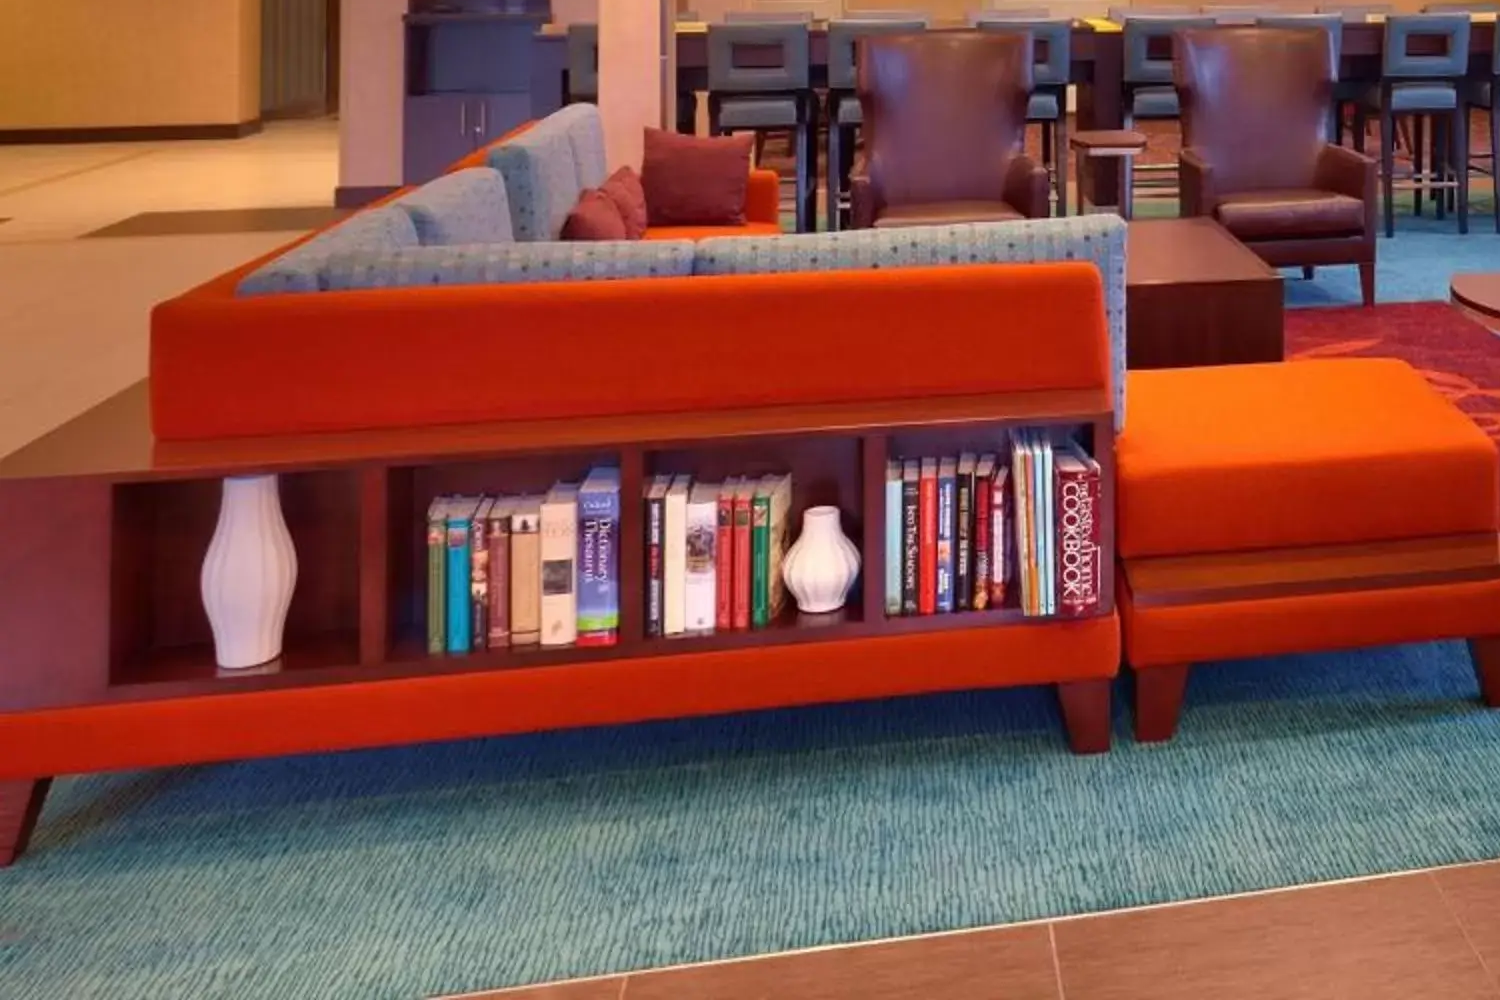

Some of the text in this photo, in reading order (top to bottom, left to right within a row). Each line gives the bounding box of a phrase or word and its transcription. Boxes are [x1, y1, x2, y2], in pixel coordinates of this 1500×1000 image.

[583, 520, 597, 584] Thesaurus
[594, 518, 612, 584] Dictionary
[1063, 482, 1081, 597] COOKBOOK
